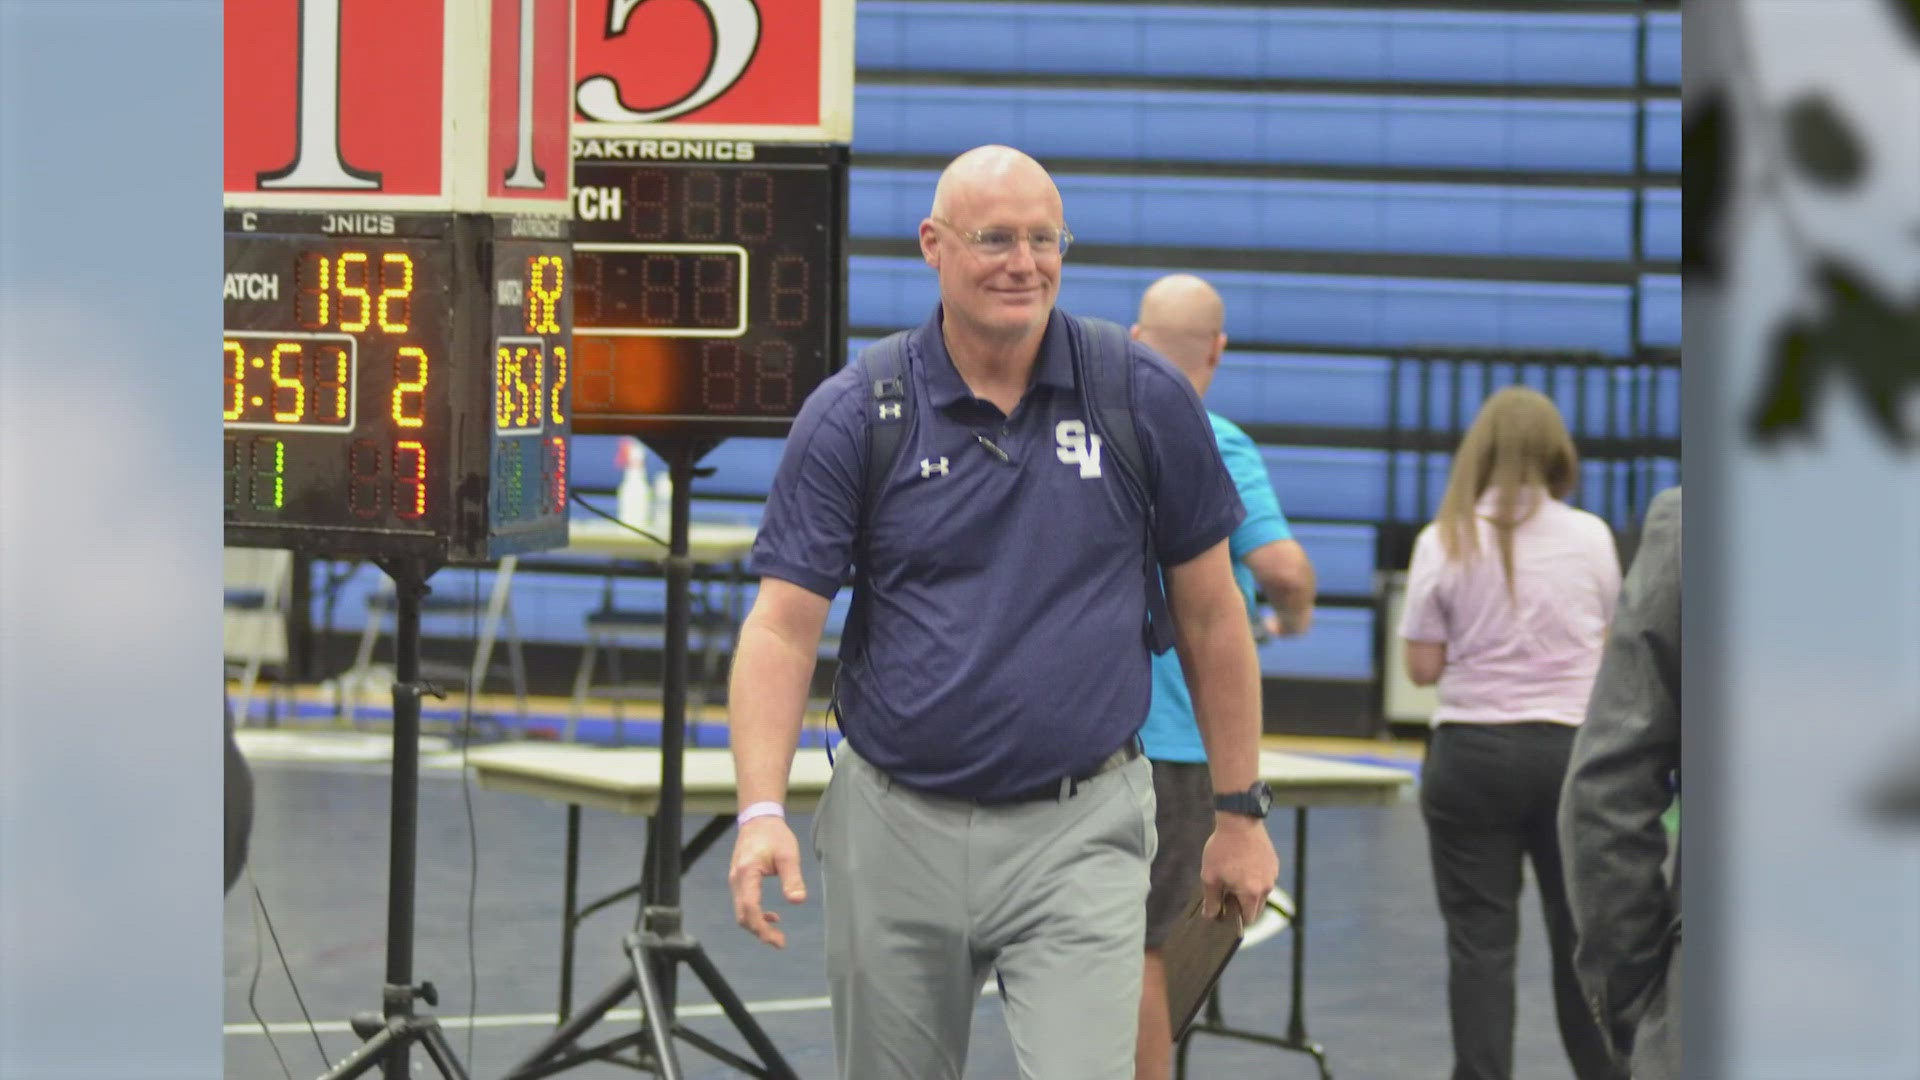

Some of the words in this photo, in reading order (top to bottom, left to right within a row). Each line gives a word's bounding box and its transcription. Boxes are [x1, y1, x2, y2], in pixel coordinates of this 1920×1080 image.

[319, 252, 413, 332] 152
[393, 346, 428, 427] 2
[275, 441, 284, 508] 1
[397, 441, 426, 514] 7
[1056, 419, 1102, 479] SV
